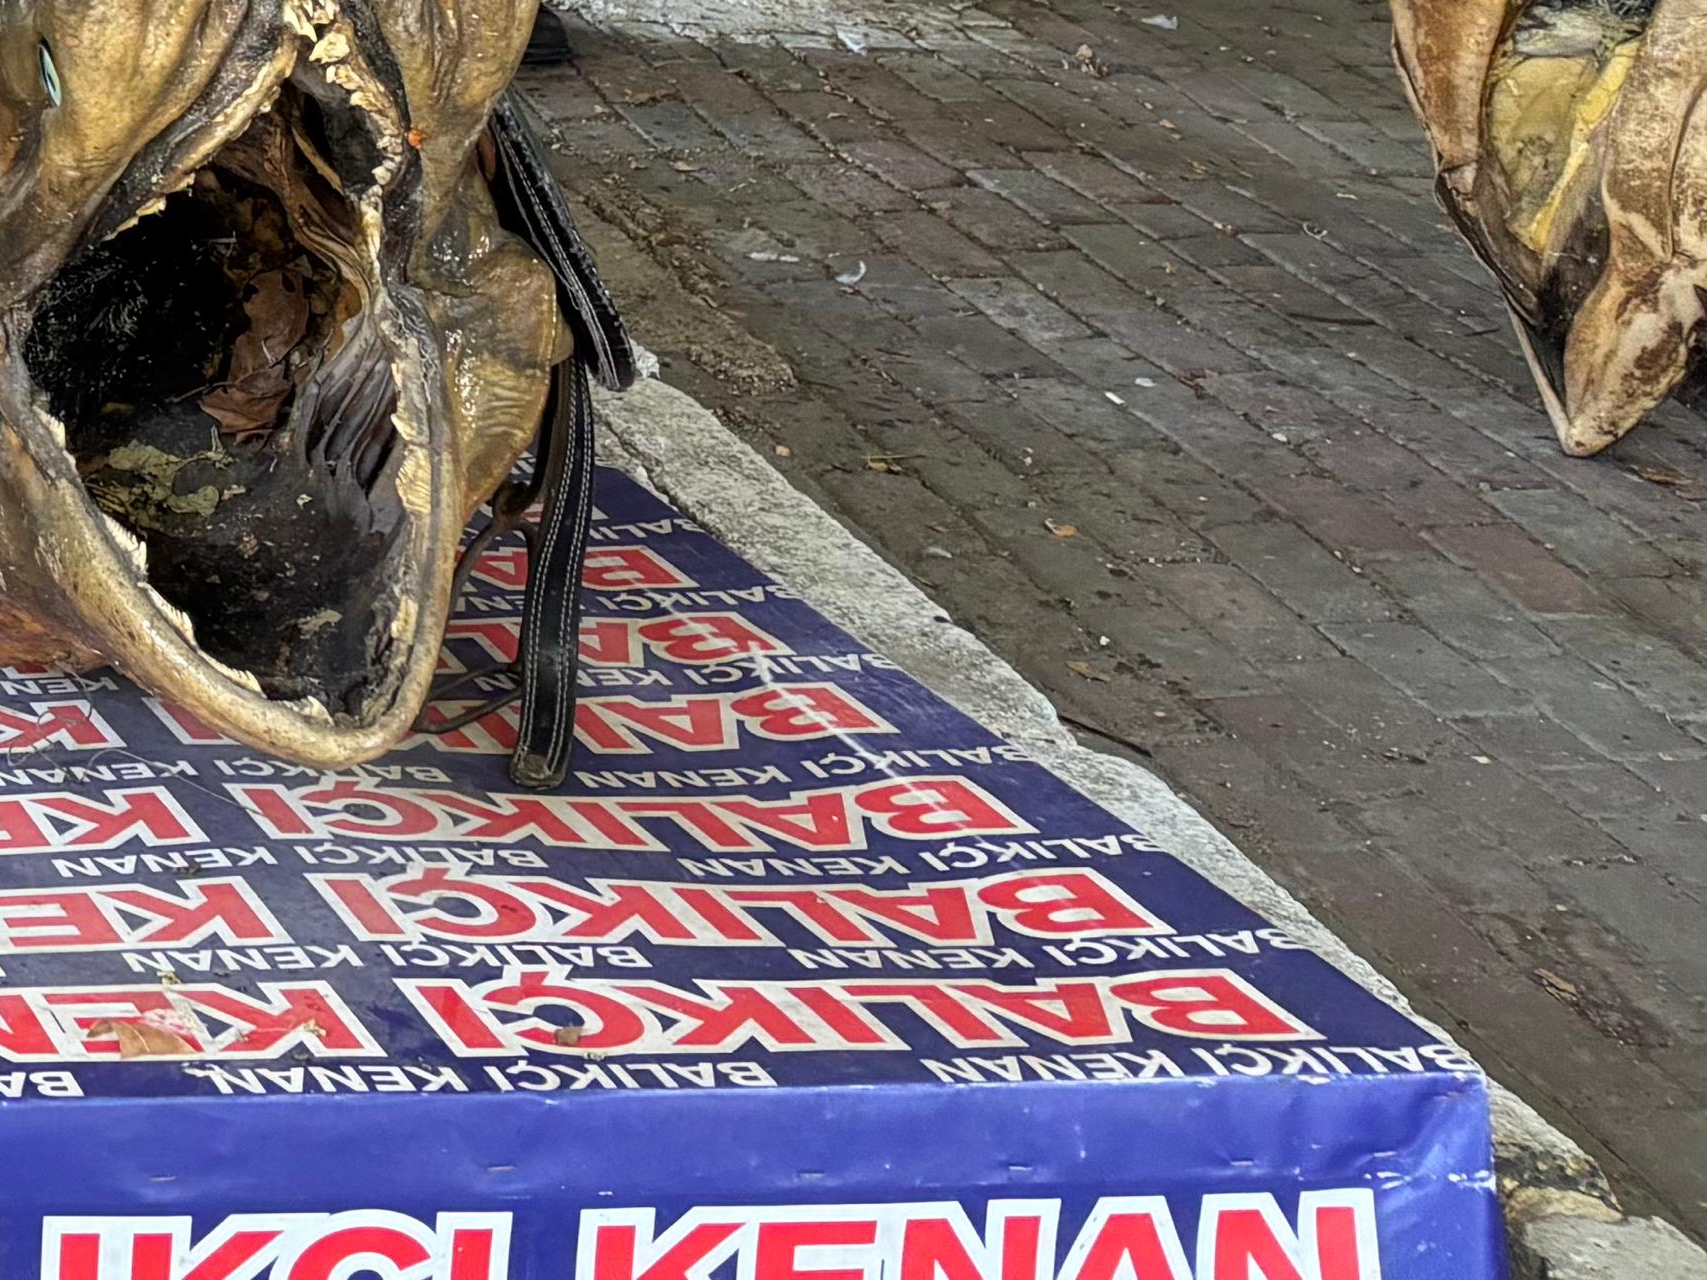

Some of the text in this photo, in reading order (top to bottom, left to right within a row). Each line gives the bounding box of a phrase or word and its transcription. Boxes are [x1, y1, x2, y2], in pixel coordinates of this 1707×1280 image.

[576, 742, 1038, 792] BALIKÇI KENAN
[223, 769, 1036, 853] BALIKÇI
[50, 843, 550, 878] BALIKÇI KENAN
[677, 834, 1173, 878] BALIKÇI KENAN
[304, 855, 1178, 947] BALIKÇI
[120, 939, 654, 973] BALIKÇI KENAN
[786, 929, 1310, 971] BALIKÇI KENAN
[392, 964, 1328, 1057] BALIKÇI
[207, 1057, 779, 1095] BALIKÇI KENAN
[919, 1041, 1478, 1084] BALIKÇI KENAN
